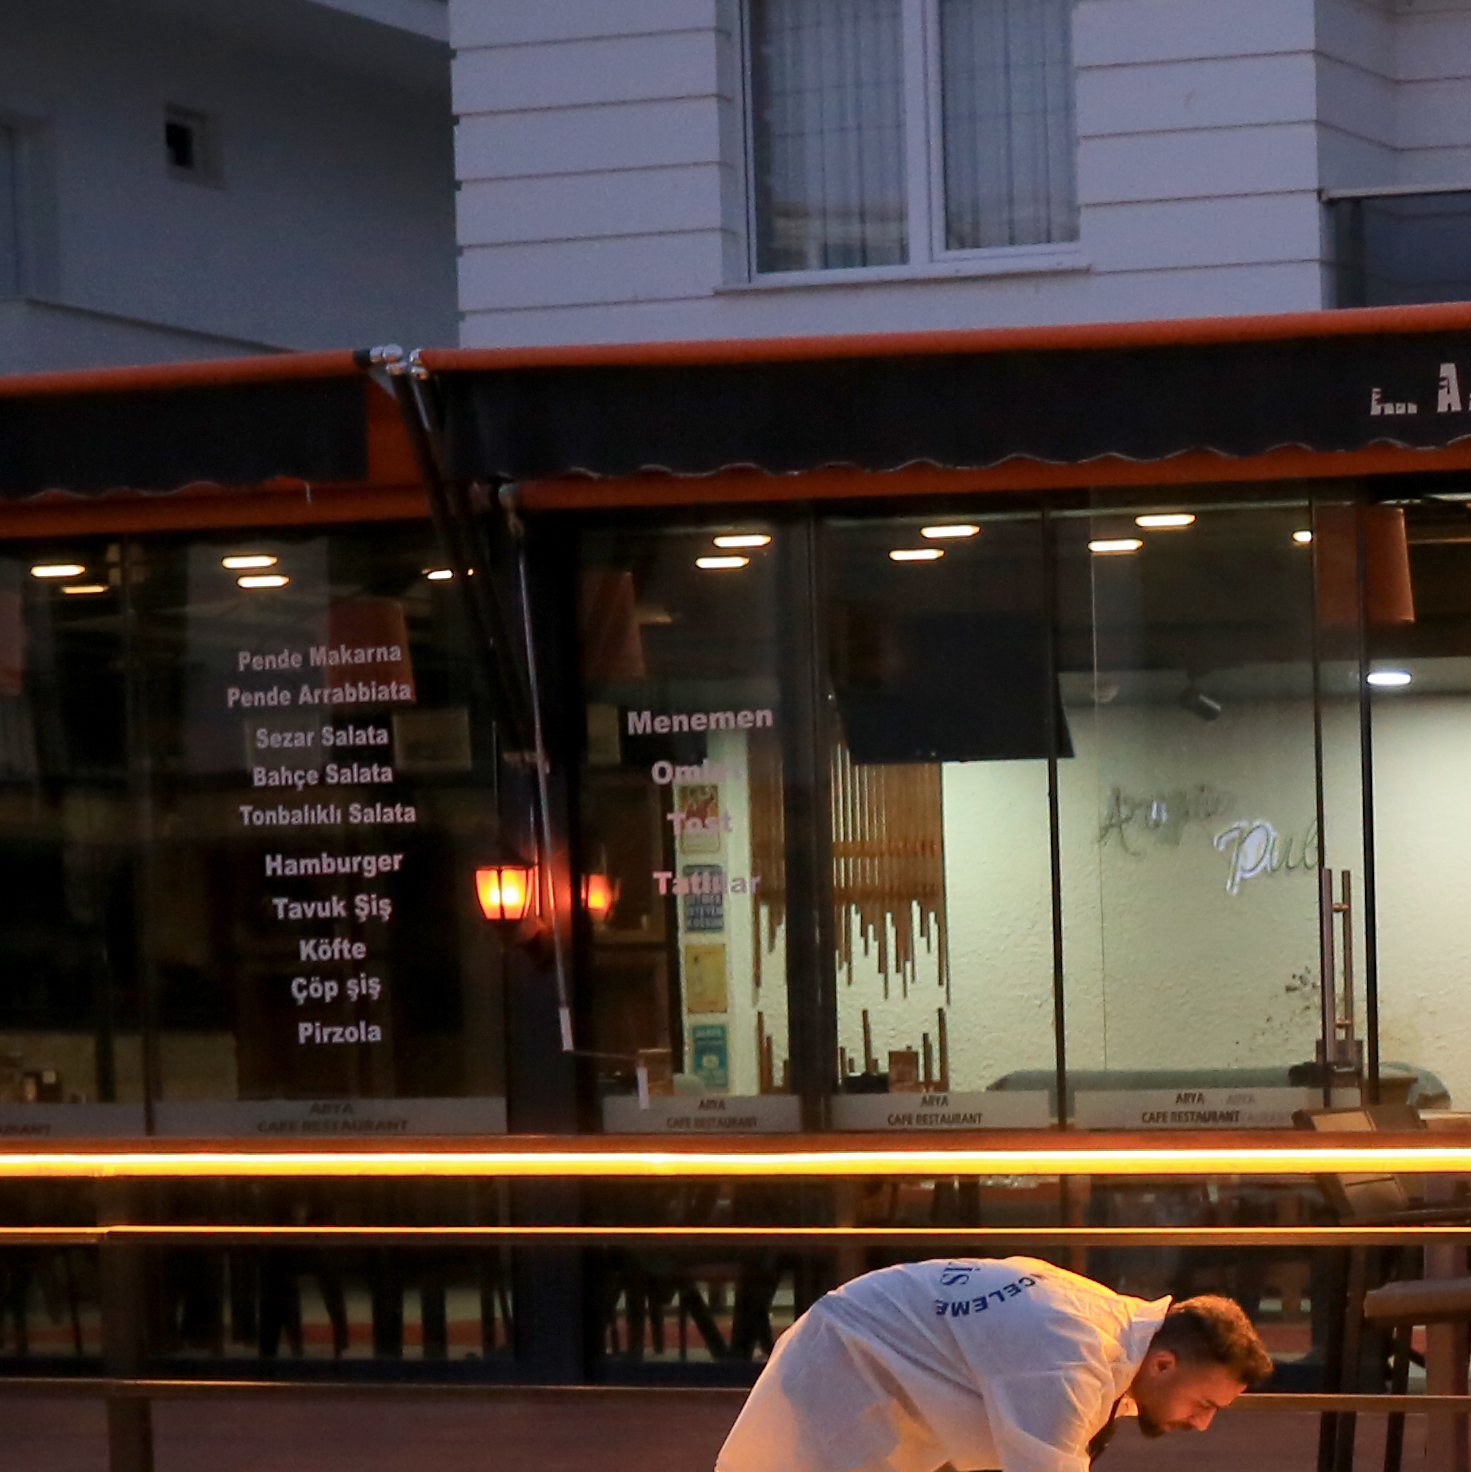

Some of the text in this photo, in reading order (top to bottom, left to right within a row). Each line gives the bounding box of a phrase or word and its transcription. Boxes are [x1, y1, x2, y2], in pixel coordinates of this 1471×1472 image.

[238, 644, 402, 671] Pende Makarna
[227, 681, 414, 708] Pende Arrabbiata
[627, 708, 773, 736] Menemen
[256, 725, 389, 749] Sezar Salata
[253, 762, 393, 791] Bahçe Salata
[239, 801, 417, 826] Tonbalıklı Salata
[667, 812, 733, 836] Tost
[265, 851, 404, 878] Hamburger
[272, 893, 393, 923] Tavuk Şiş
[299, 938, 367, 962] Köfte
[291, 975, 338, 1006] Çöp
[298, 1020, 382, 1045] Pirzola
[1176, 1092, 1205, 1105] ARYA
[1142, 1111, 1168, 1124] CAFE
